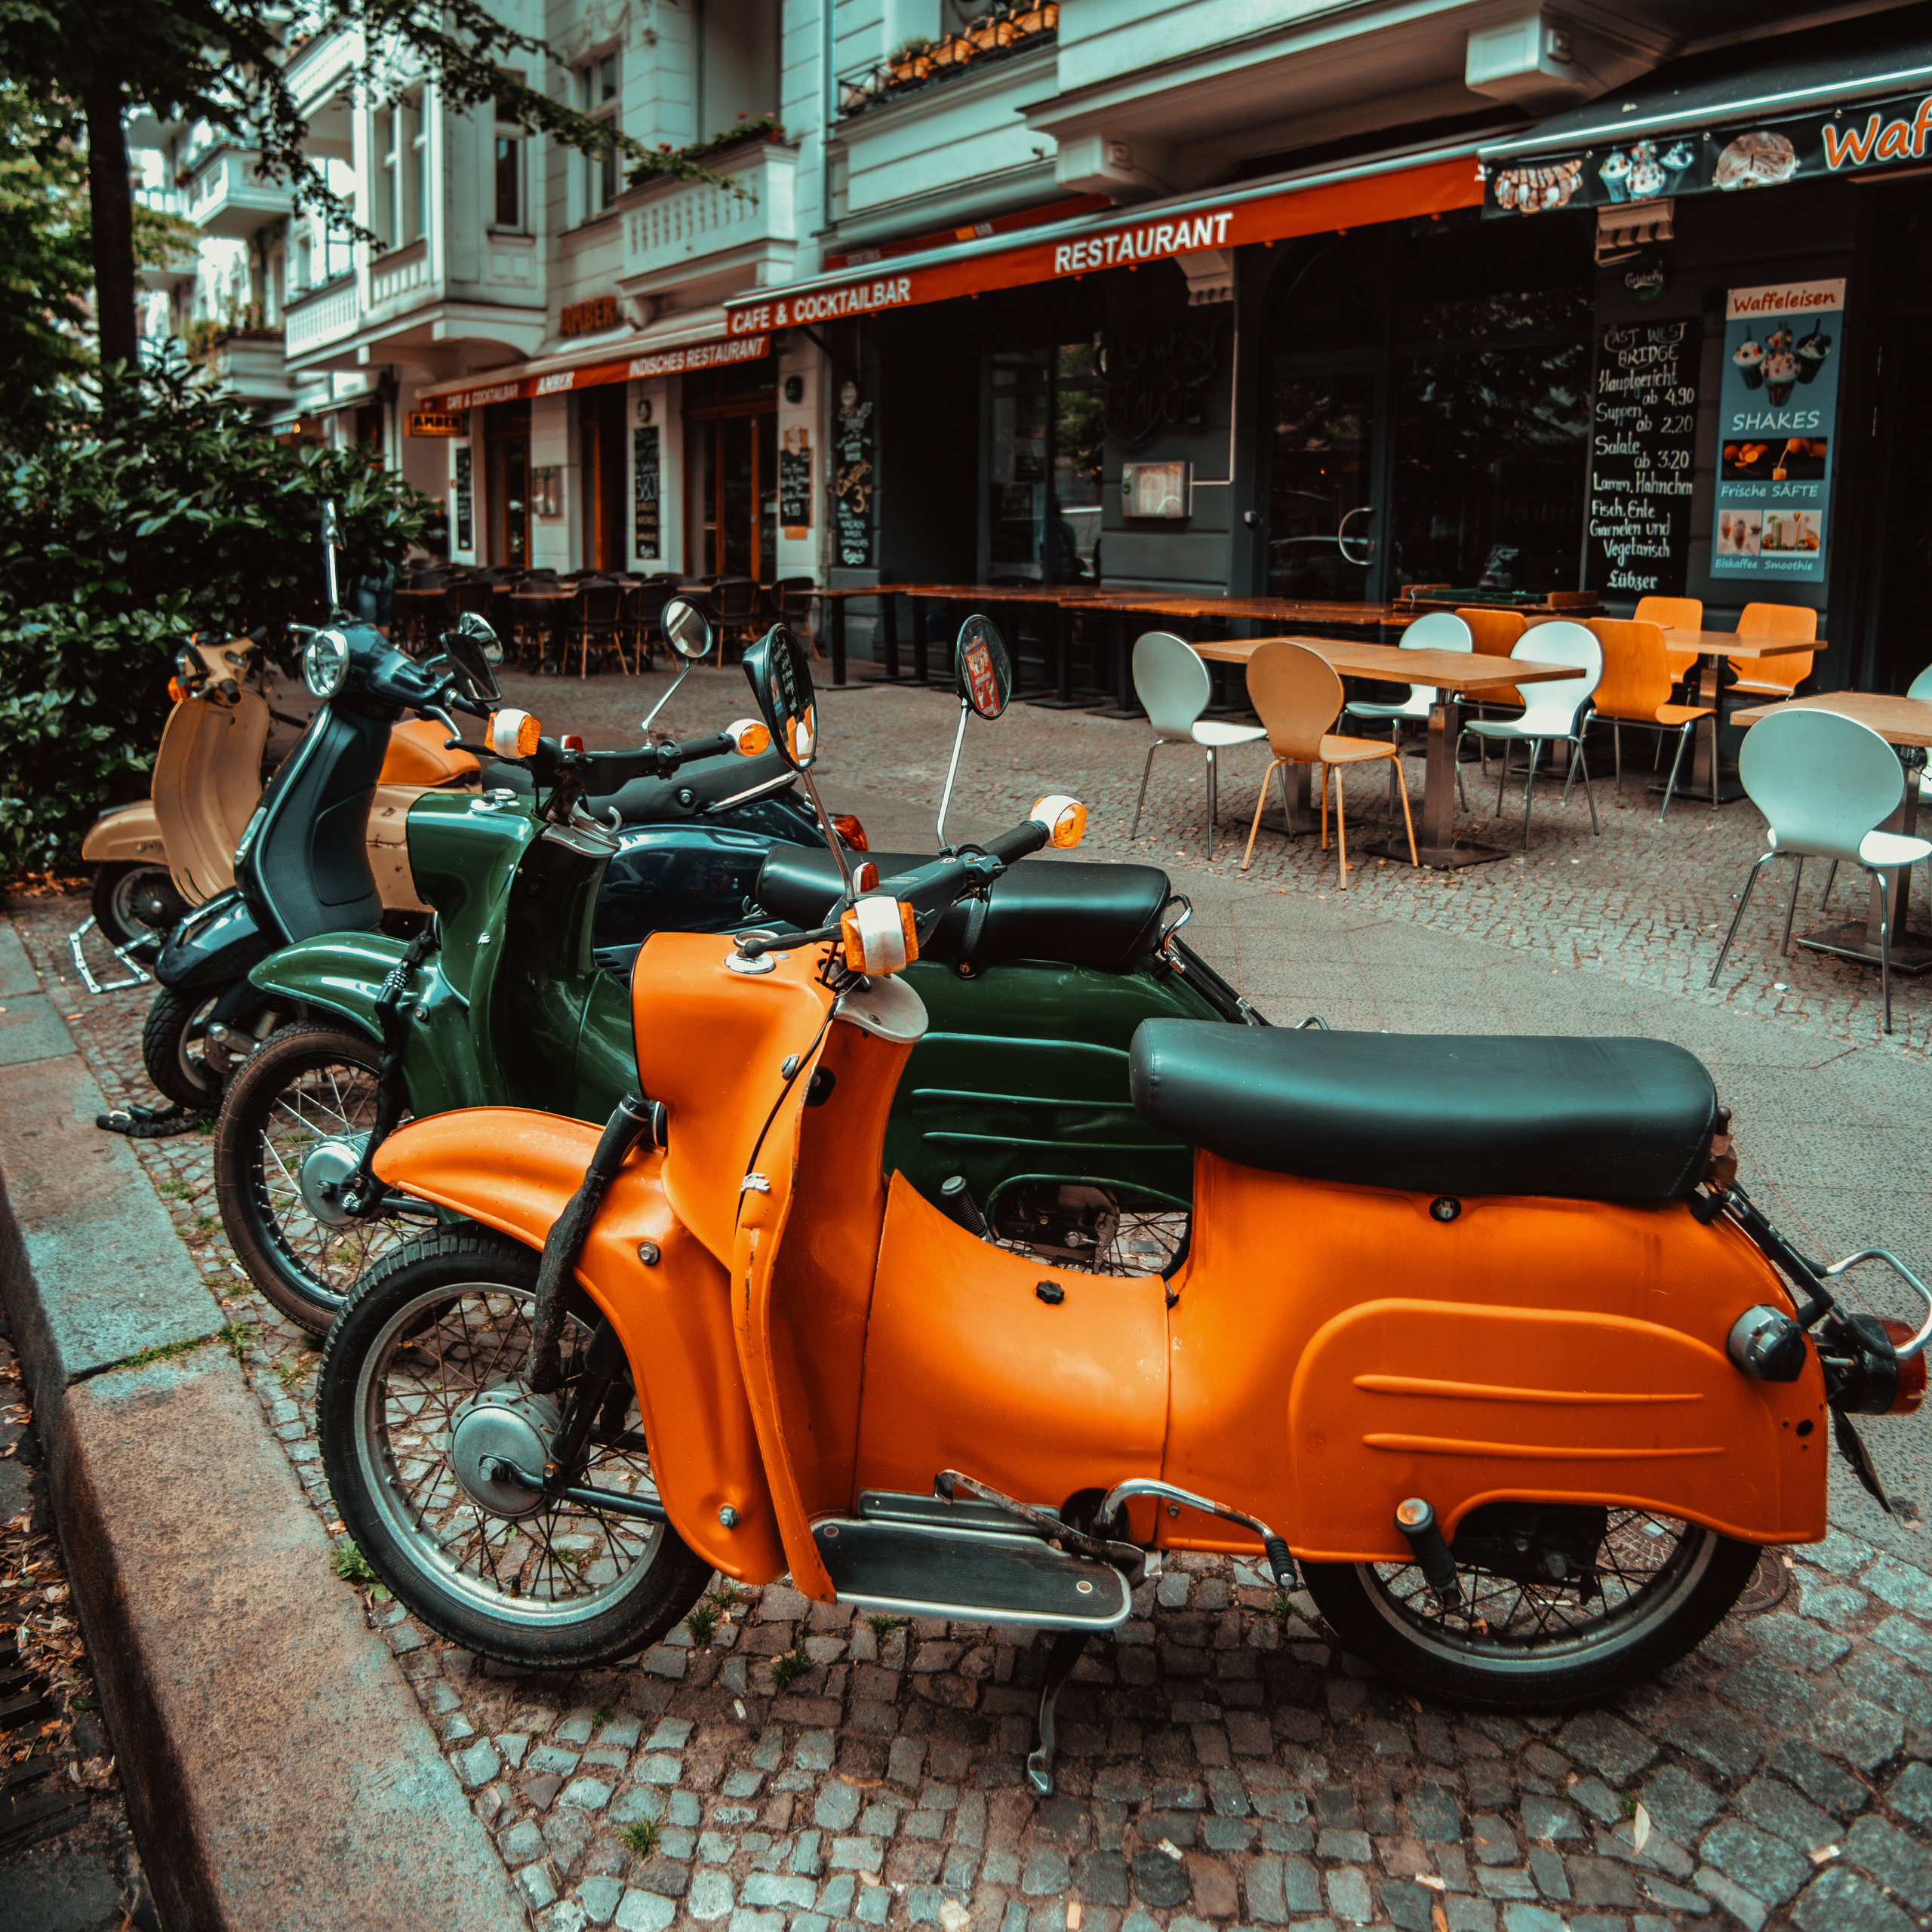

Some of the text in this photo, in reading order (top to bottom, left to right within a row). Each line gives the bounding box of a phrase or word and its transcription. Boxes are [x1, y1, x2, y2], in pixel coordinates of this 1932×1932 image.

[1054, 211, 1234, 274] RESTAURANT
[1625, 269, 1663, 288] Carlsberg
[731, 276, 911, 334] CAFE & COCKTAILBAR
[1734, 290, 1836, 313] Waffeleisen
[560, 294, 618, 336] AMBER
[629, 352, 685, 377] INDISCHES
[685, 337, 765, 368] RESTAURANT
[1618, 343, 1679, 371] BRIDGE
[447, 393, 462, 410] CAFE
[472, 383, 519, 406] COCKTAILBAR
[1642, 389, 1658, 406] ab
[1595, 402, 1642, 427] Suppen
[1636, 414, 1653, 432] ab
[1732, 410, 1820, 431] SHAKES
[1595, 431, 1640, 456] Salate
[1634, 451, 1651, 469] ab
[1721, 481, 1820, 498] Frische SÄFTE
[1590, 512, 1671, 537] Garnelen und
[1603, 536, 1671, 568] Vegetarisch
[1715, 557, 1814, 571] Eiskaffee Smoothie
[1607, 569, 1659, 592] Lübzer
